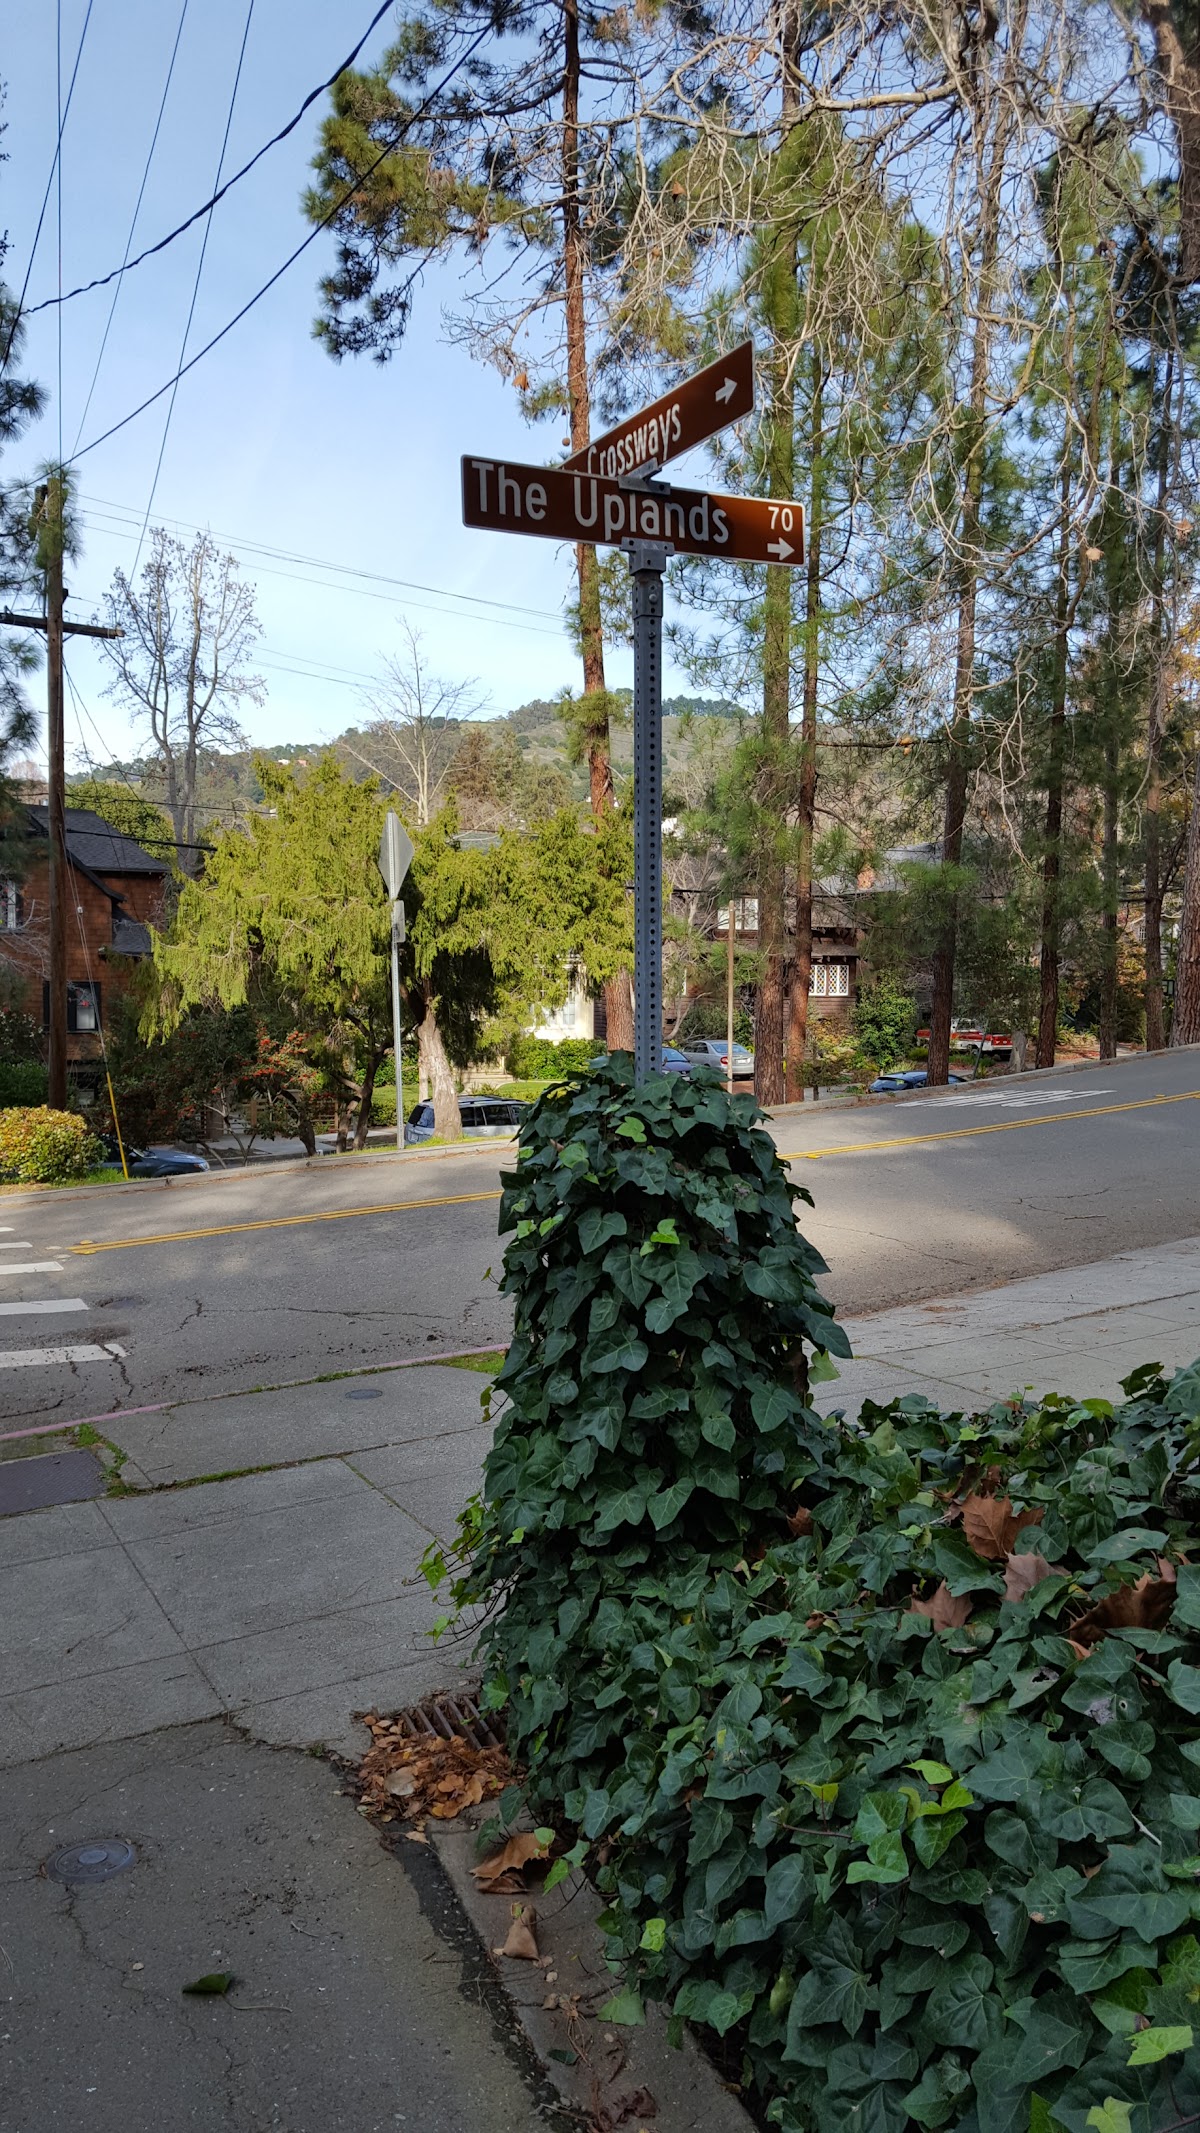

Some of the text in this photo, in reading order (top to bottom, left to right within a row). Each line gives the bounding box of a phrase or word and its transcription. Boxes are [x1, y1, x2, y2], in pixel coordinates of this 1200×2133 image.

[587, 403, 681, 477] Crossways
[471, 460, 729, 544] The Uplands
[767, 506, 793, 532] 70
